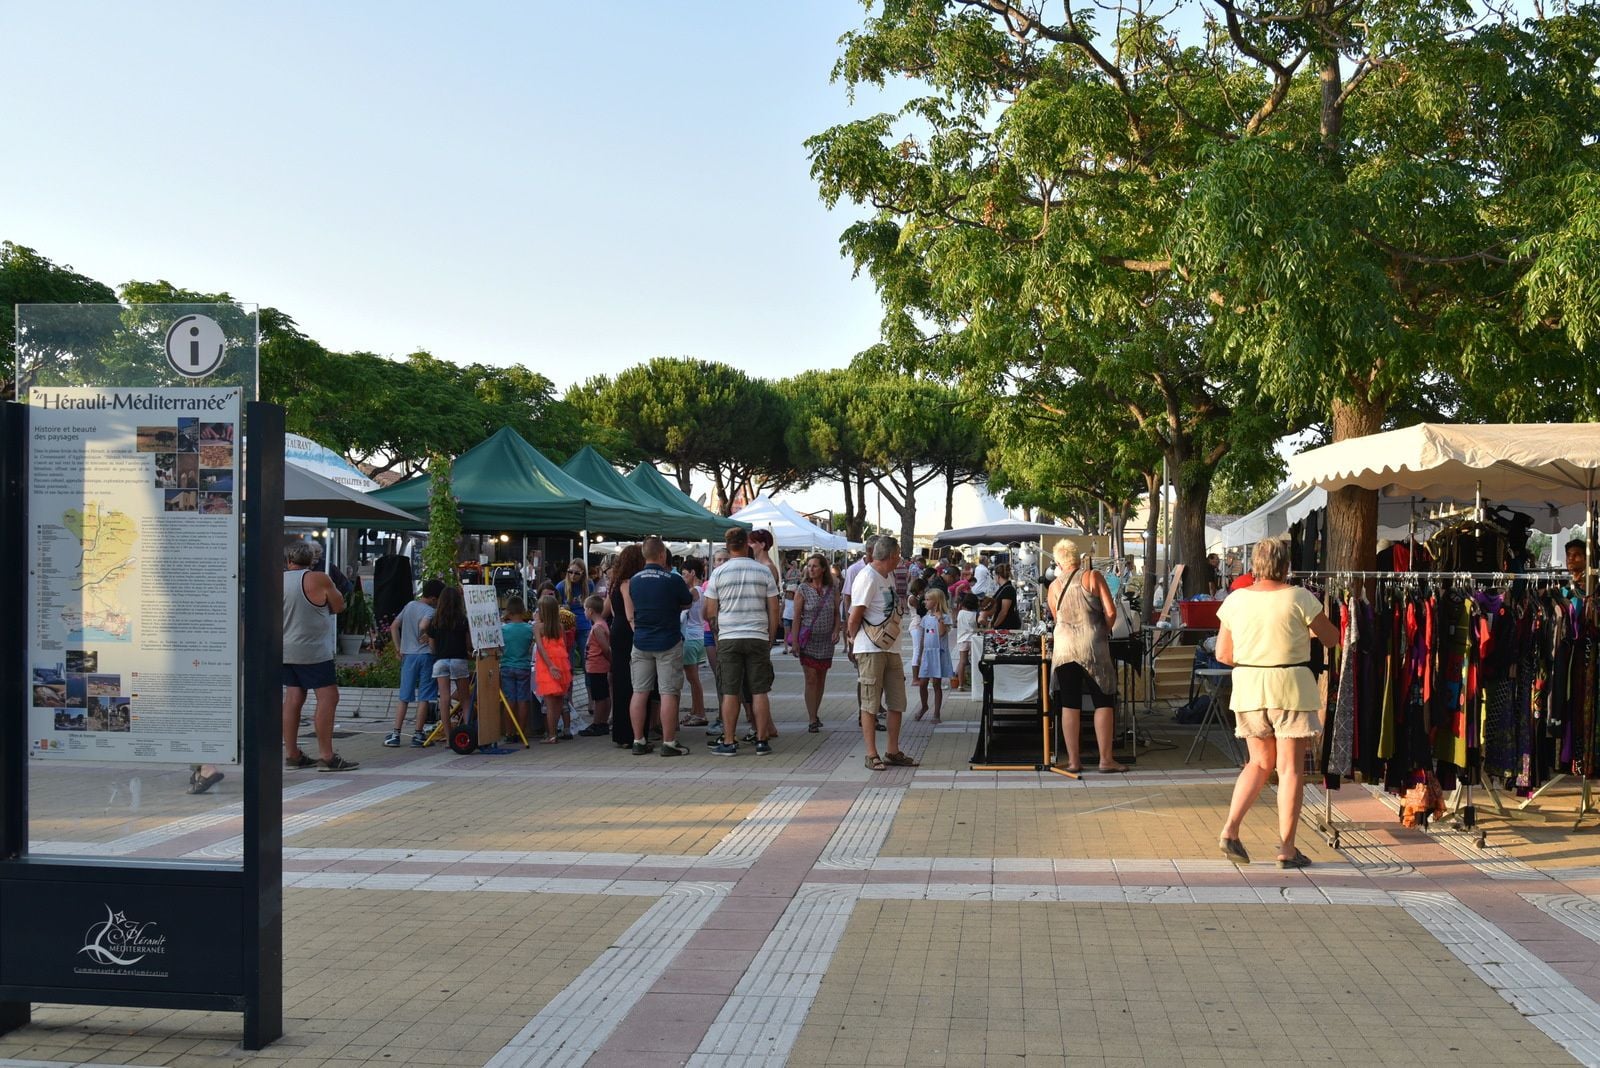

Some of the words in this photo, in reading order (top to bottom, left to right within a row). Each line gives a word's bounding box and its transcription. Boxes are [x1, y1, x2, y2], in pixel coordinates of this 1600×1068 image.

[72, 425, 97, 433] beauté
[48, 434, 79, 442] paysages
[124, 921, 166, 945] Hérault
[109, 944, 165, 954] MÉDITERRANÉE
[73, 967, 115, 975] Communauté
